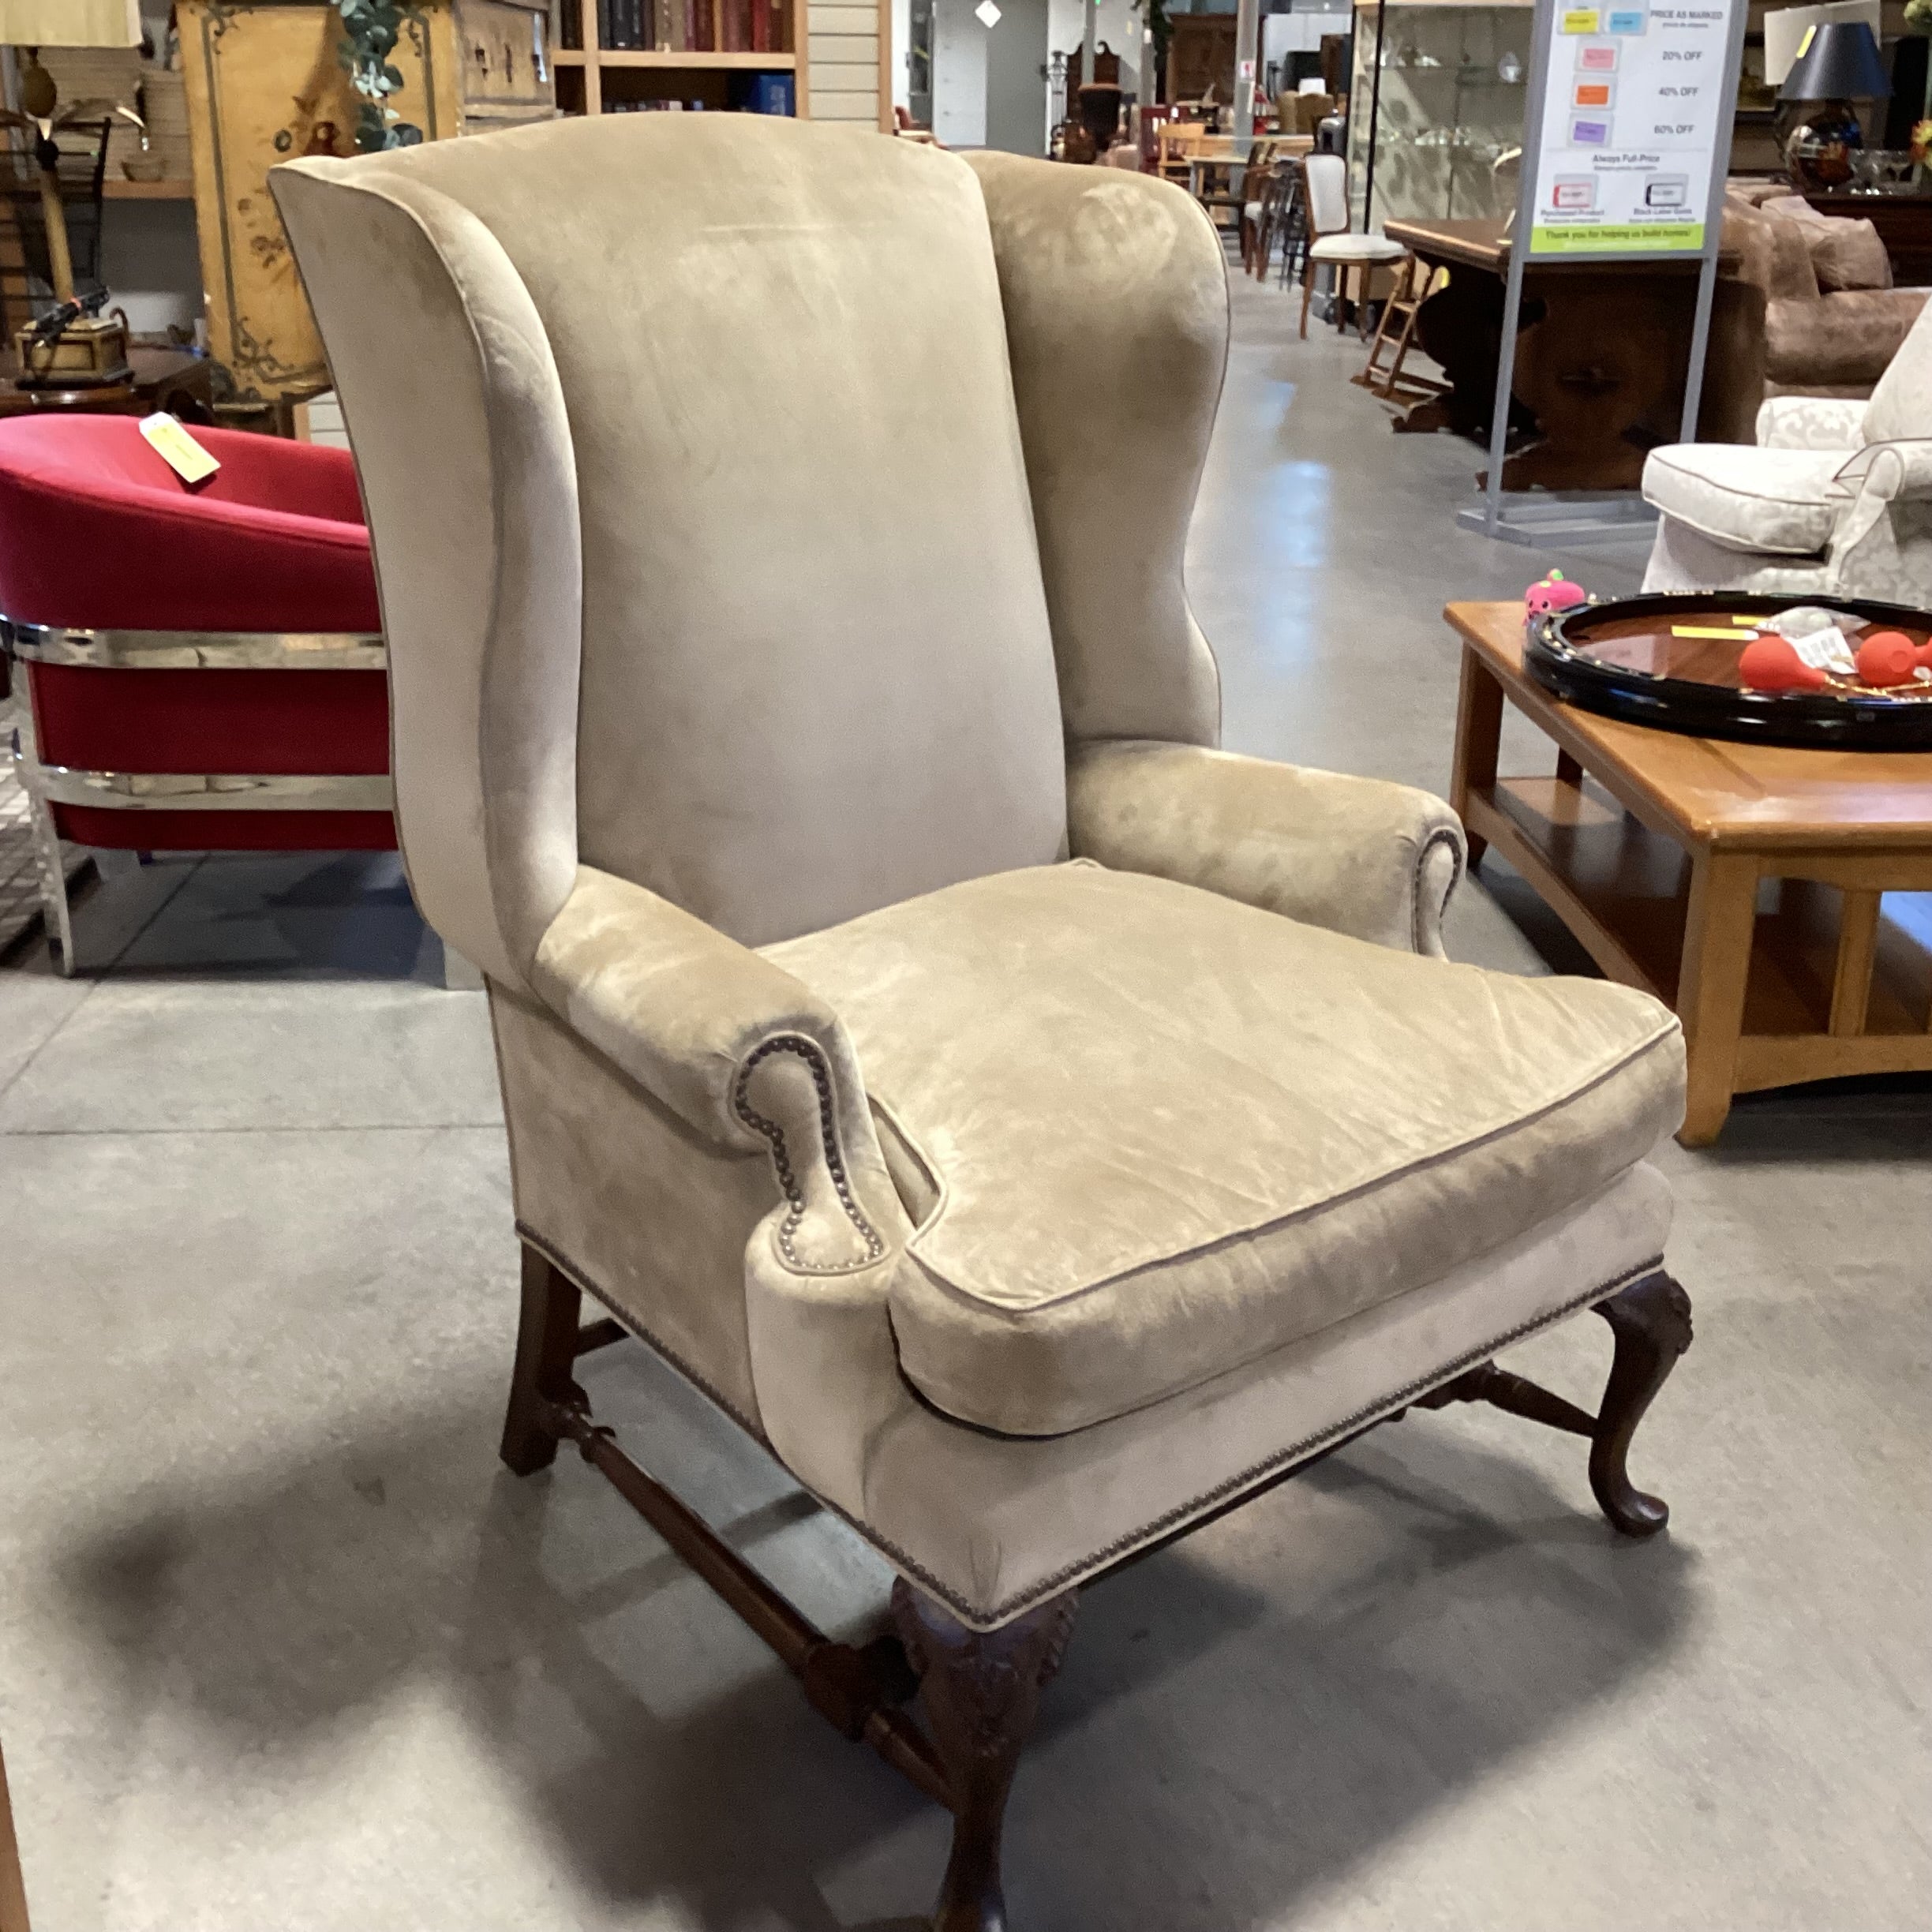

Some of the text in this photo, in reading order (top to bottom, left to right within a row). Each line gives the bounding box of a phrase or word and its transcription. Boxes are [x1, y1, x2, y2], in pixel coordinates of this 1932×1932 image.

[1651, 9, 1674, 18] PRICE
[1689, 11, 1723, 20] MARKED
[1663, 51, 1702, 60] 20% OFF
[1659, 87, 1698, 96] 40% OFF
[1676, 124, 1694, 133] OFF
[1593, 154, 1620, 163] Always
[1571, 232, 1586, 241] you
[1601, 230, 1630, 239] helping
